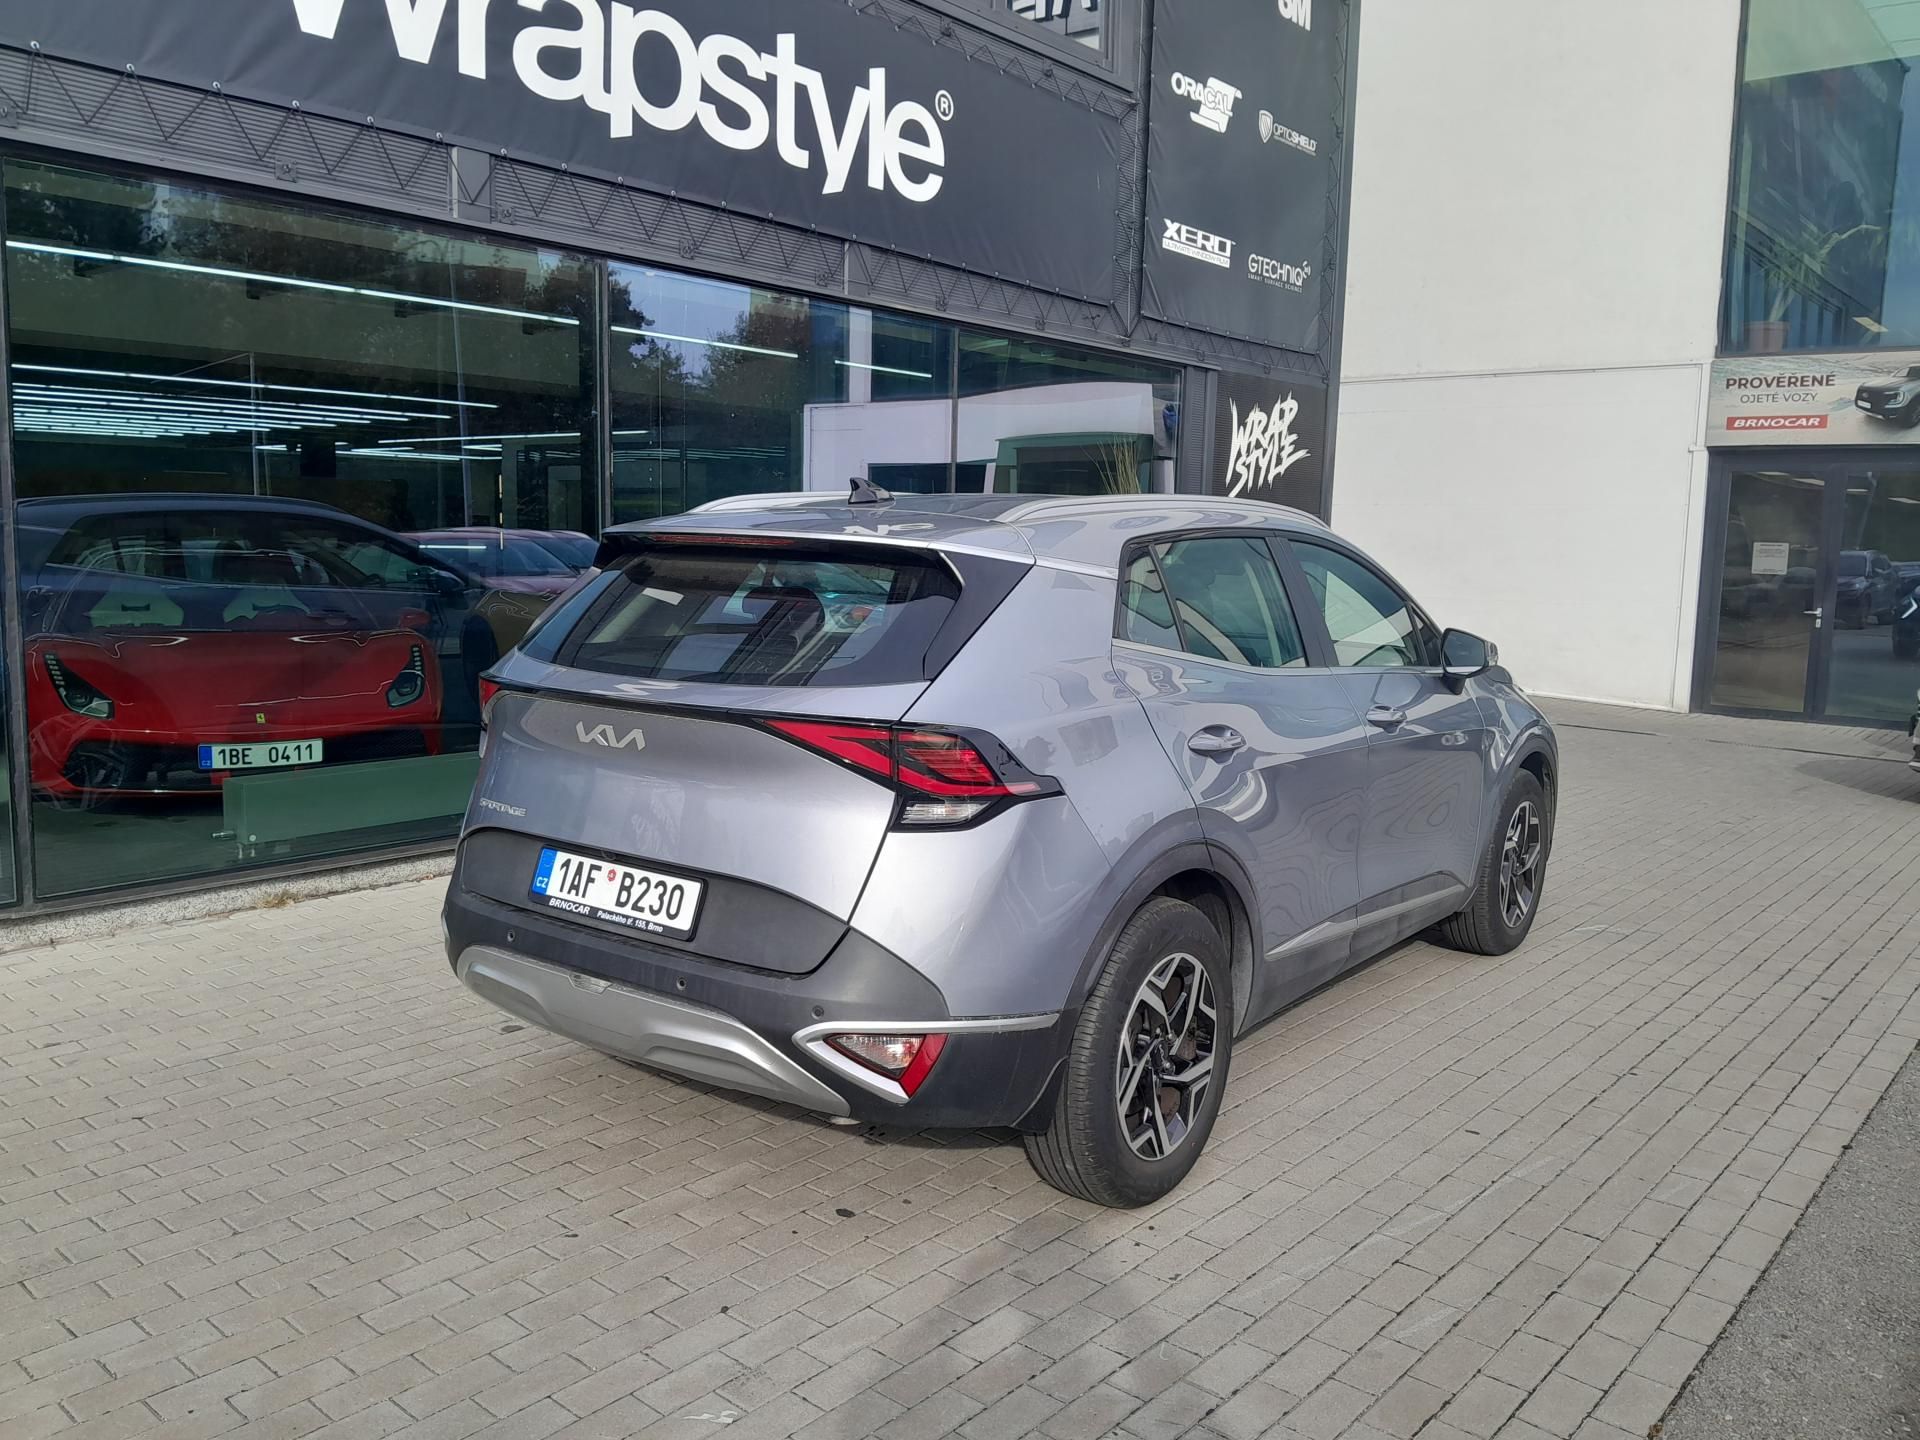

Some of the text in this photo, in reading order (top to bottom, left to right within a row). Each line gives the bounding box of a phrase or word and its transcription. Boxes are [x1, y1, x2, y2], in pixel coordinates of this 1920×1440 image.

[1170, 71, 1233, 117] ORACAL
[1162, 217, 1232, 257] XERO
[1726, 371, 1837, 390] PROVĚŘENÉ
[1782, 392, 1818, 403] VOZY
[1733, 417, 1821, 429] BRNOCAR
[217, 743, 314, 766] 1BE 0411
[536, 876, 548, 888] CZ
[559, 857, 685, 921] 1AF B230
[549, 897, 591, 915] BRNOCAR
[596, 910, 627, 923] Palackého
[647, 922, 664, 933] Brno
